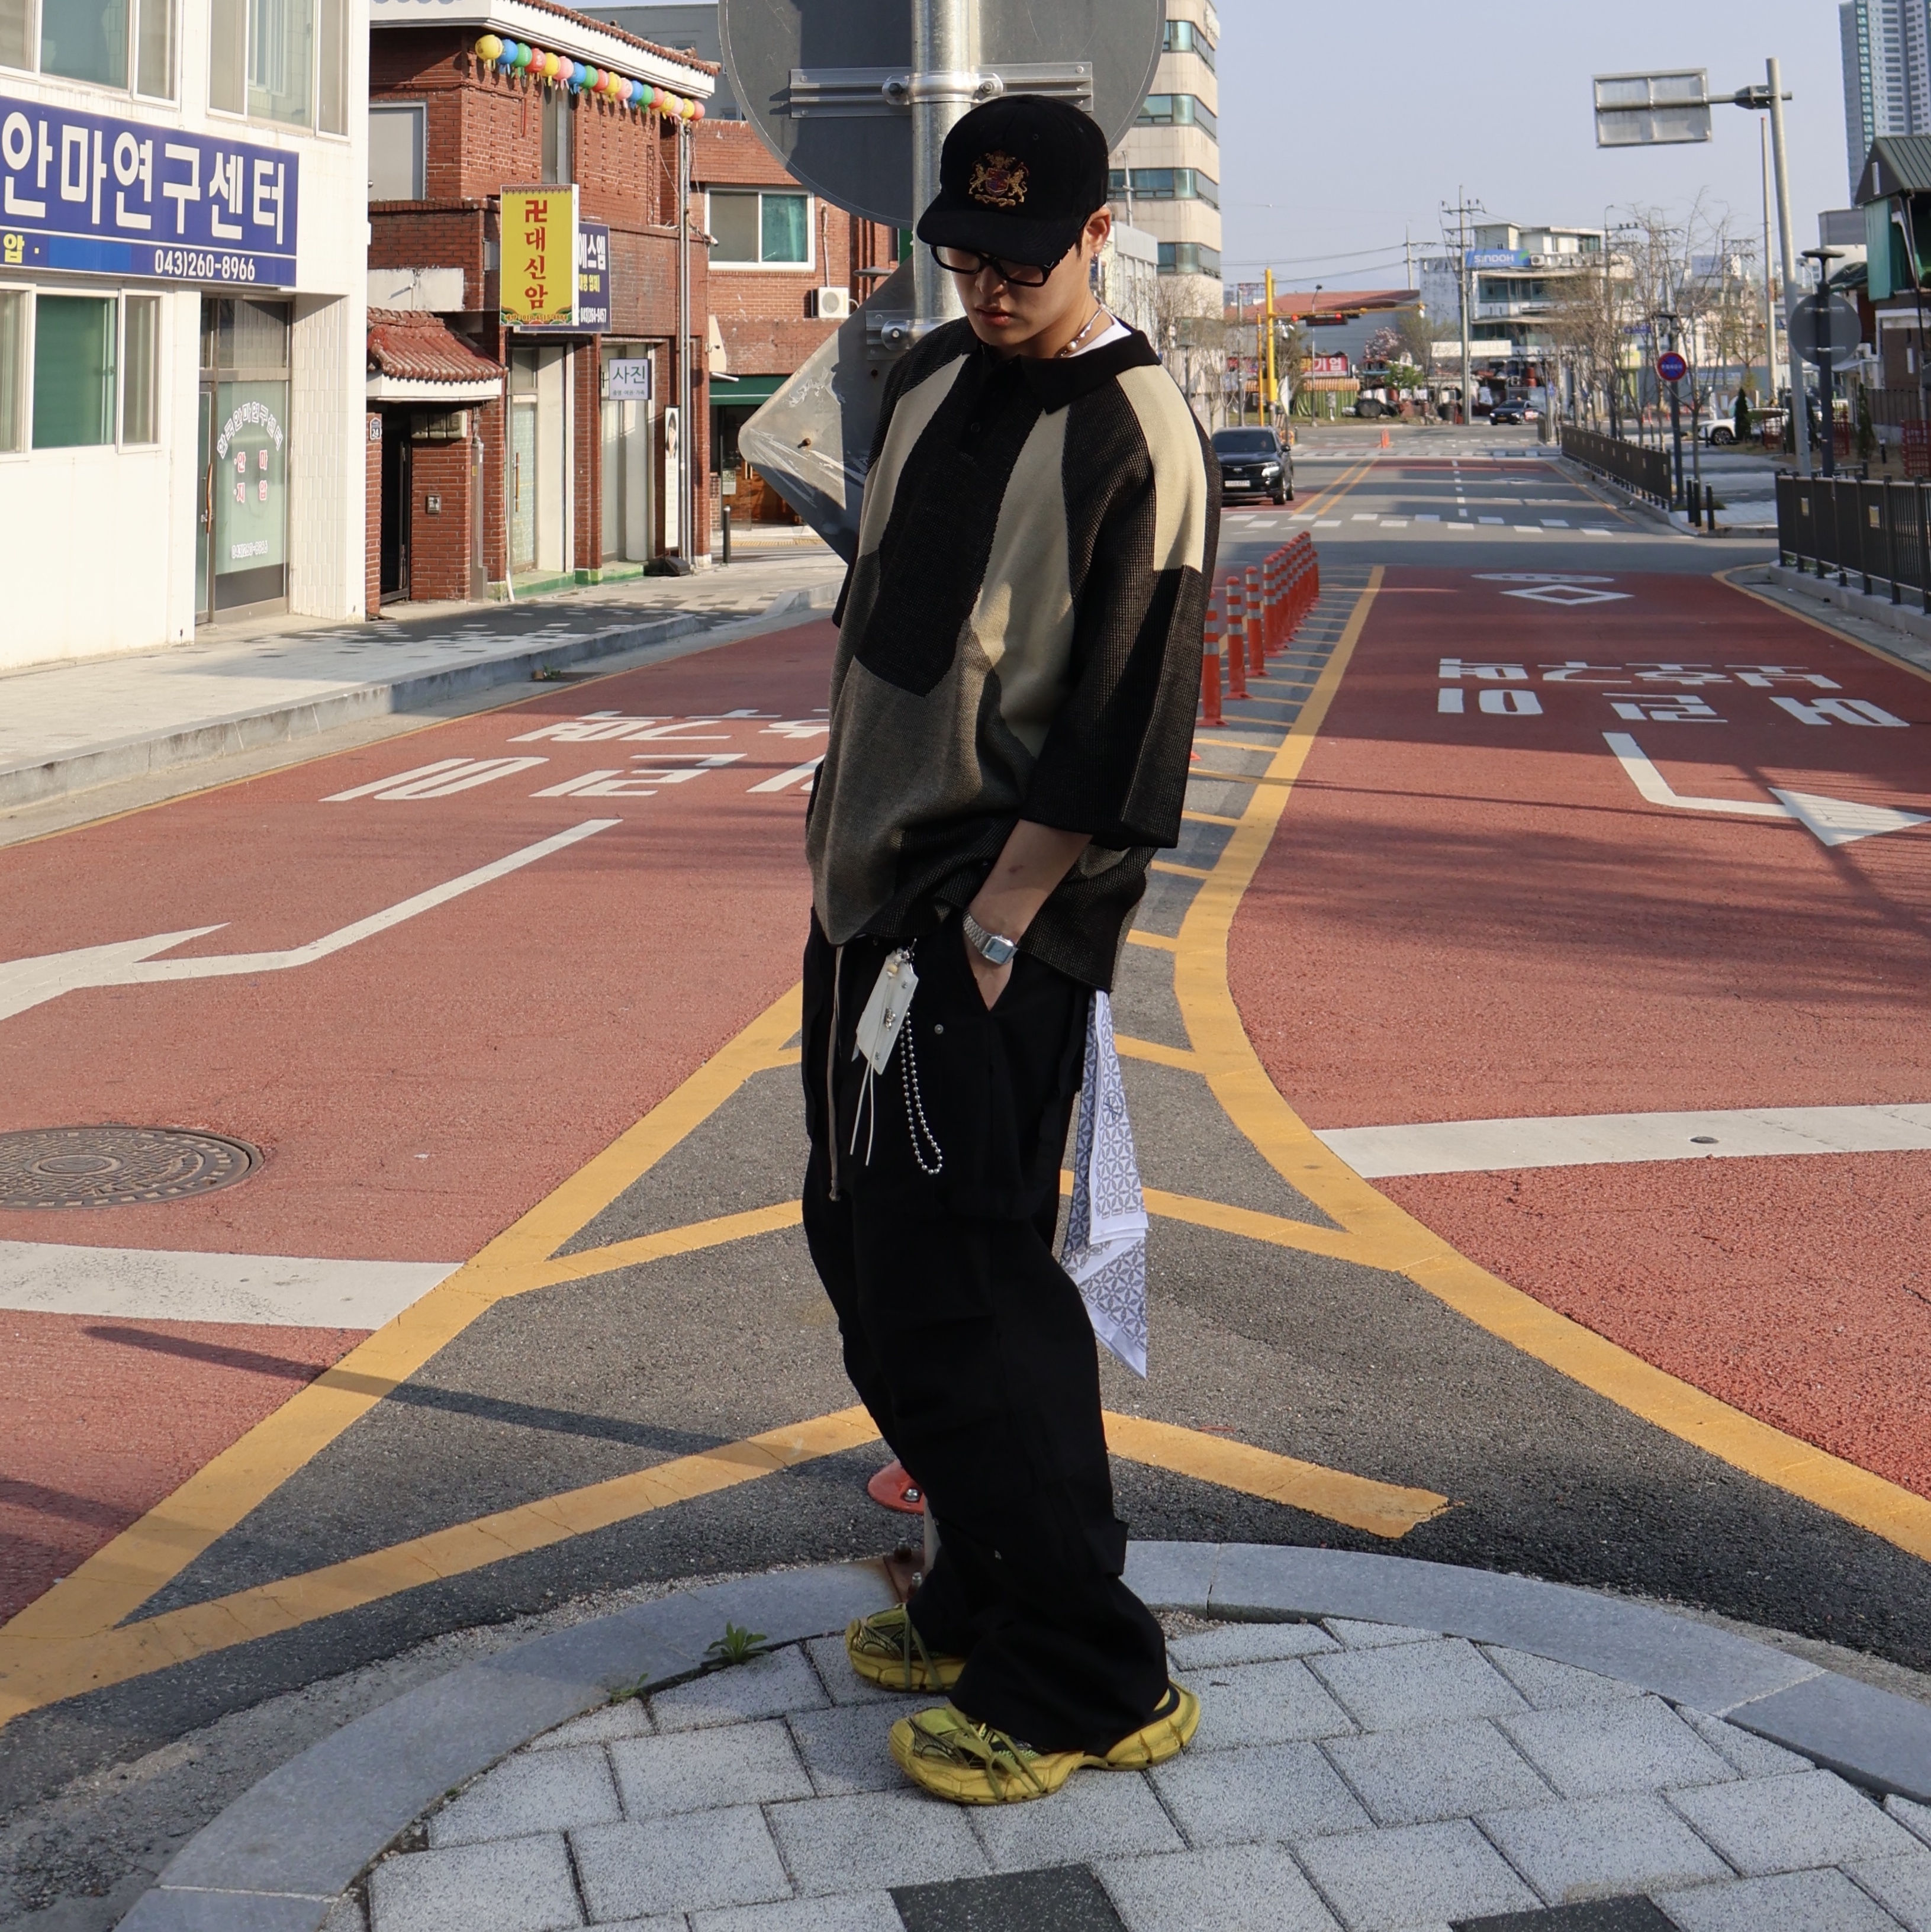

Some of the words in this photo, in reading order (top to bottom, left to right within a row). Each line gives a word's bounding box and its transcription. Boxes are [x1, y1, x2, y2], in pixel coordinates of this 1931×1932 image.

[2, 112, 285, 245] 안마연구센터
[155, 249, 255, 281] 043)260-8966
[613, 365, 645, 384] 사진
[372, 428, 379, 438] 24
